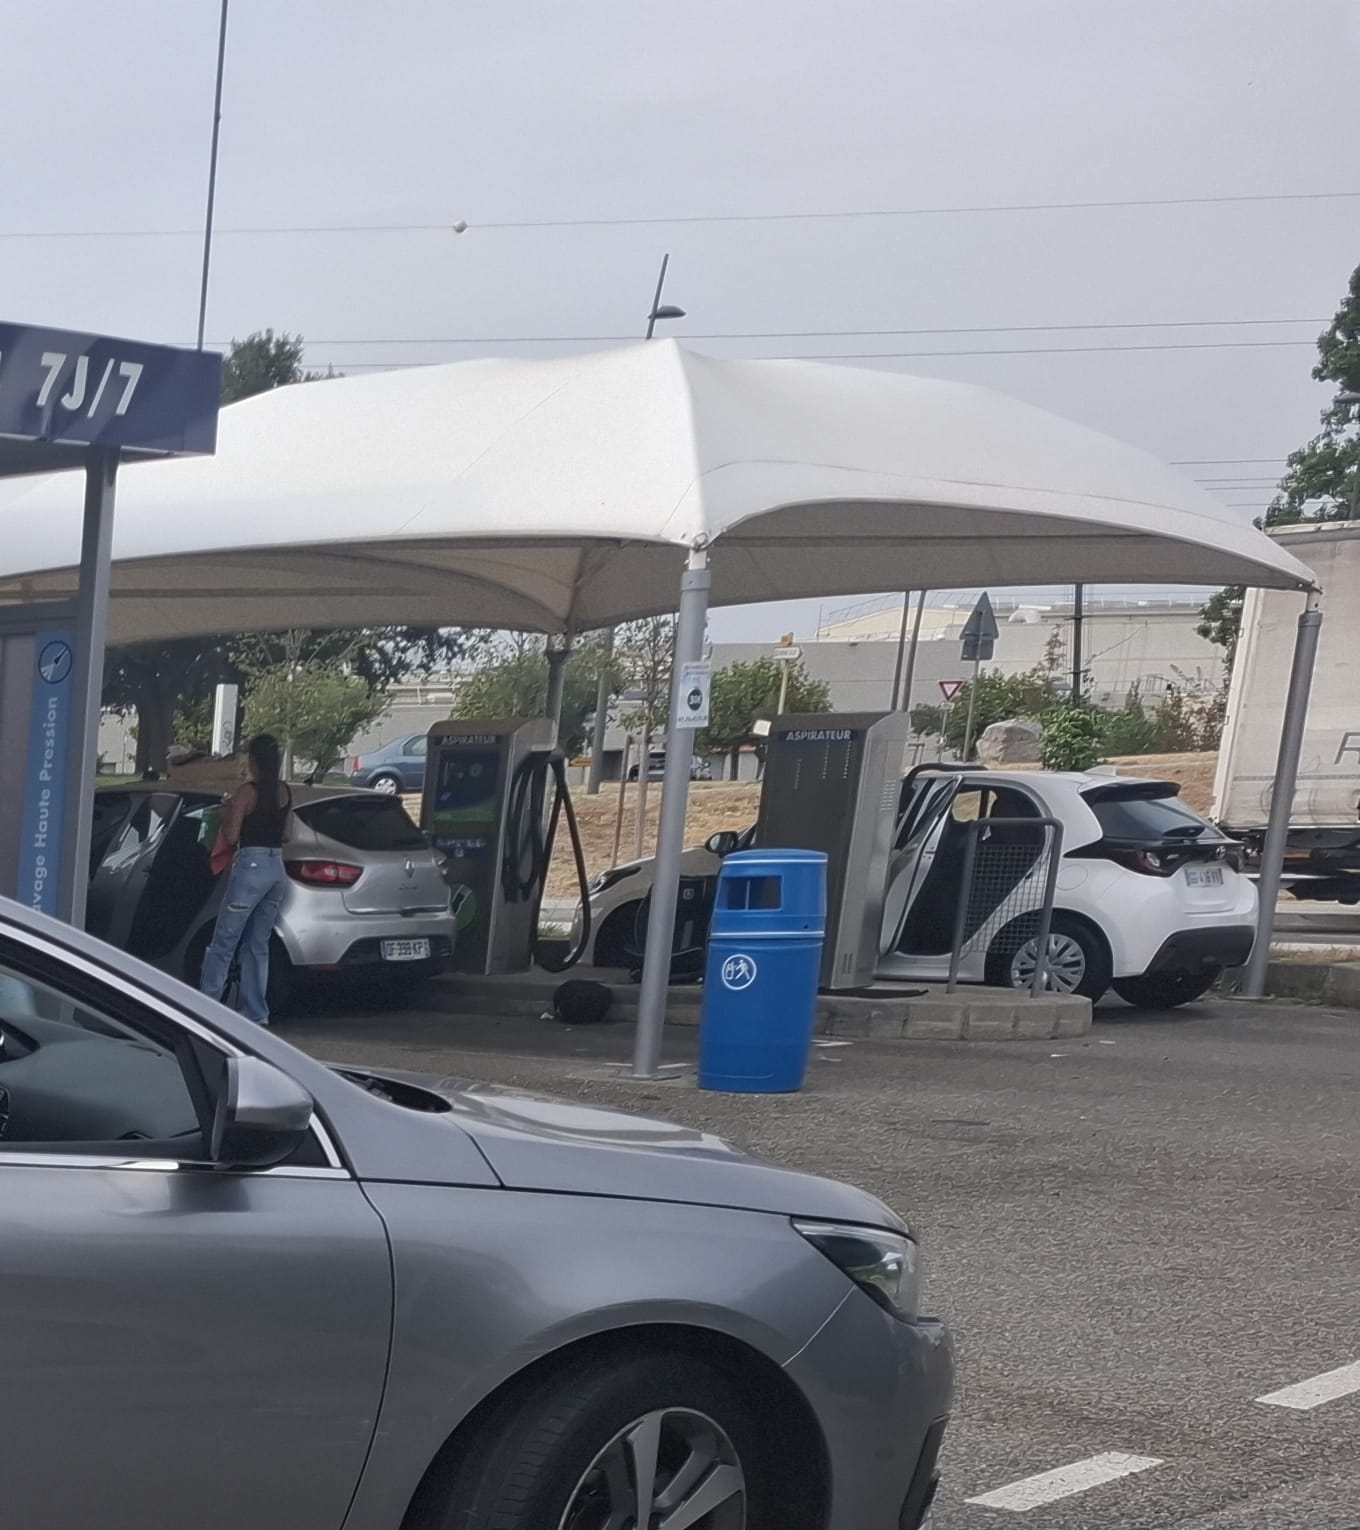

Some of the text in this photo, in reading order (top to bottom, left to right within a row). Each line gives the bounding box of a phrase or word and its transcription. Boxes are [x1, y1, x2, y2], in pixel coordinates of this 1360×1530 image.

[36, 352, 144, 419] 7J/7
[441, 735, 496, 745] ASPIRATEUR
[786, 730, 852, 741] ASPIRATEUR
[32, 697, 58, 912] avage Haute Pression
